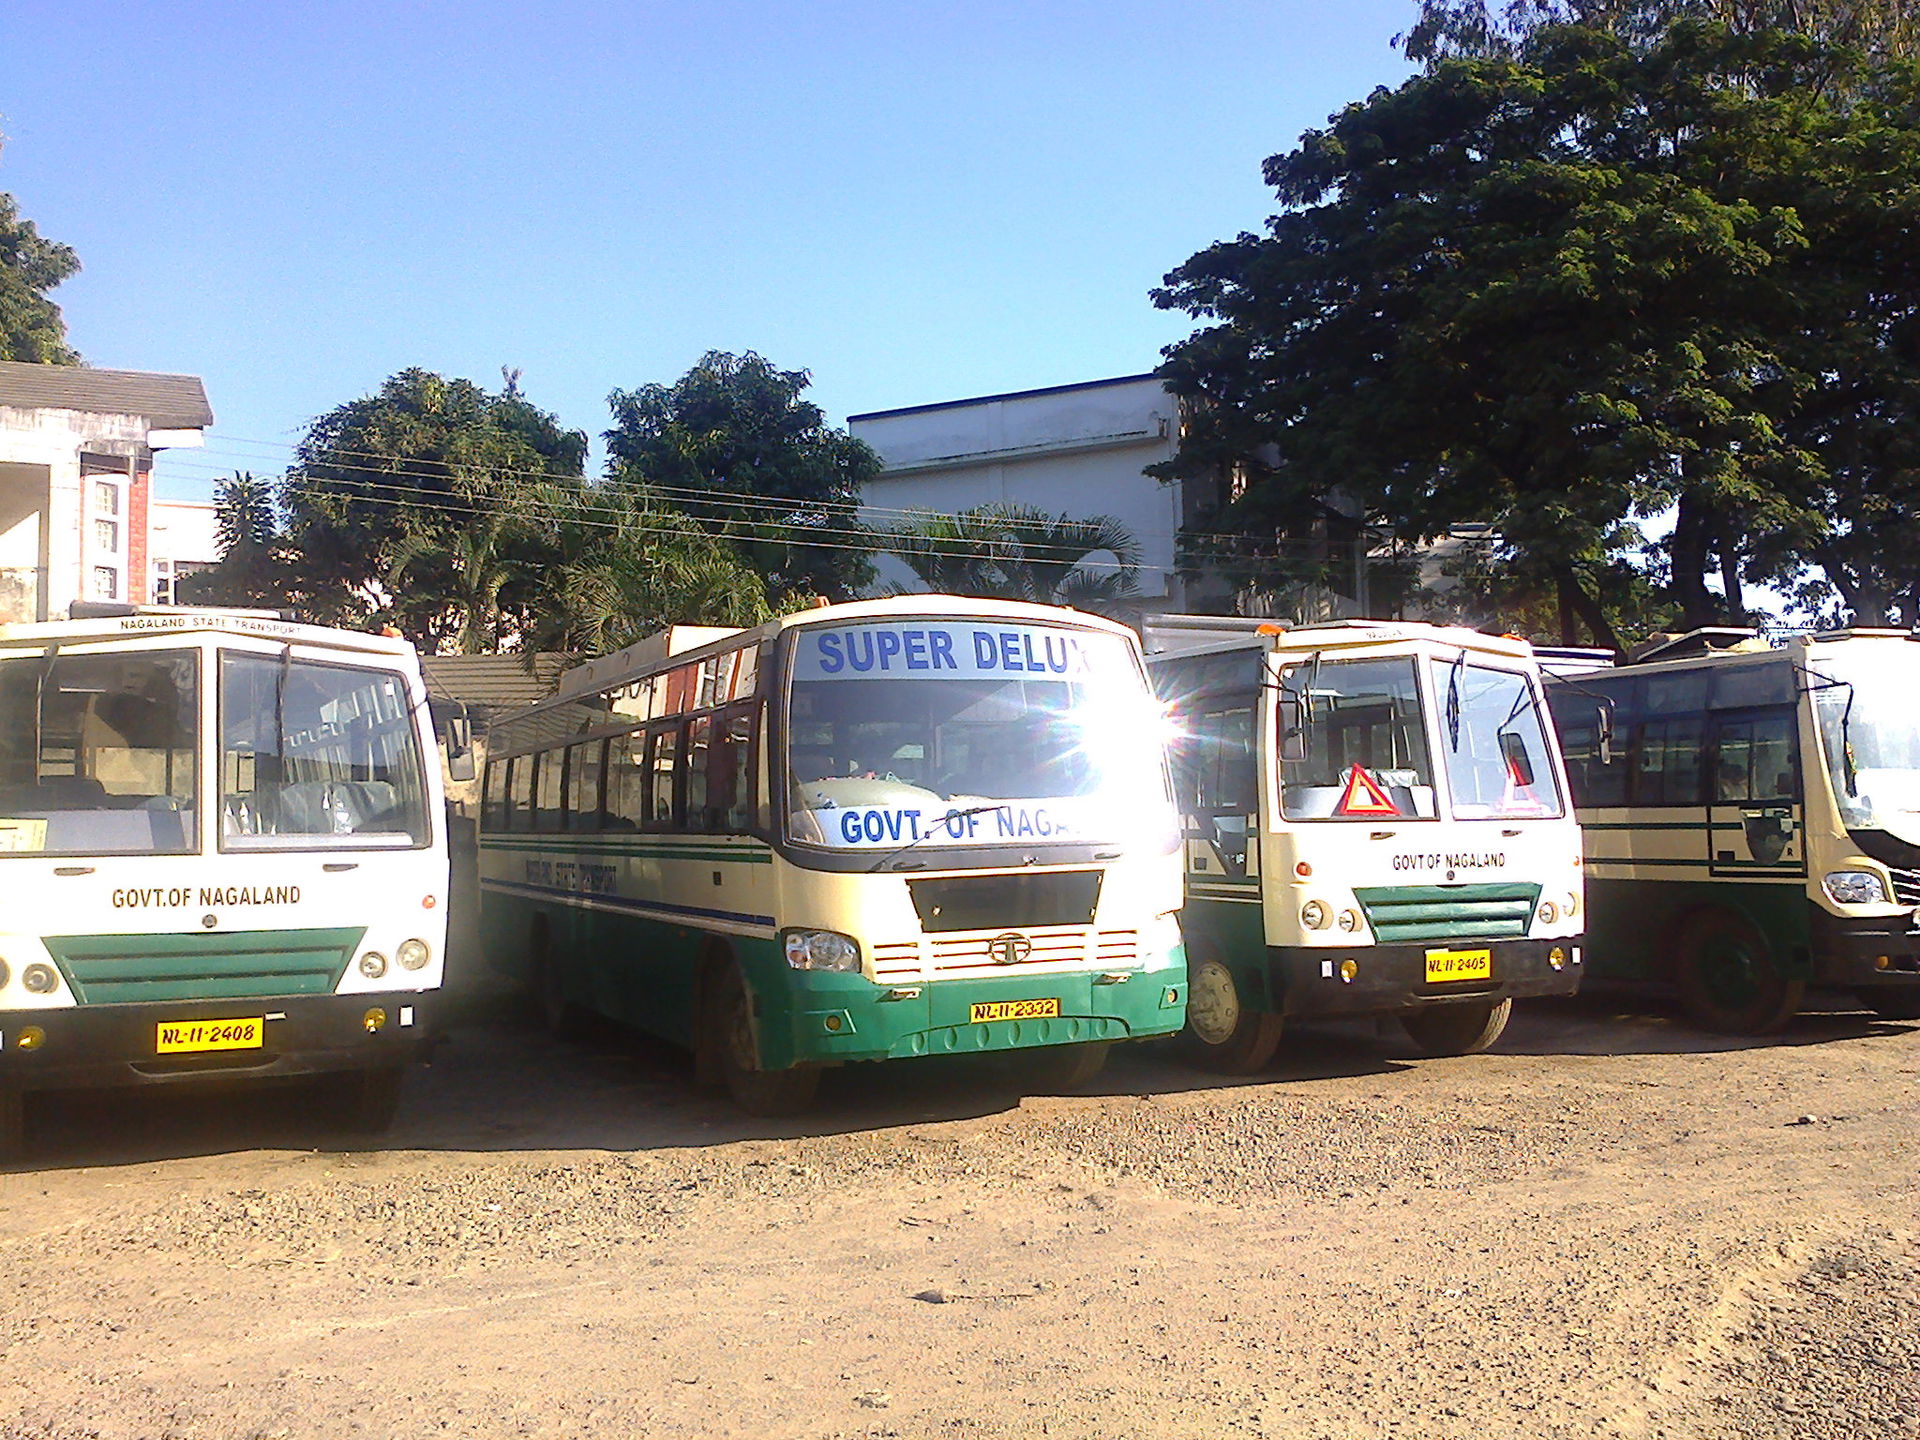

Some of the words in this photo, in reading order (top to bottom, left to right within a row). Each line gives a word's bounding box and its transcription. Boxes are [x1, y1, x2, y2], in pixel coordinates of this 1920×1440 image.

[120, 617, 186, 629] NAGALAND
[192, 617, 226, 628] STATE
[234, 619, 301, 634] TRANSPORT
[817, 630, 958, 673] SUPER
[946, 808, 980, 839] OF
[1445, 852, 1506, 868] NAGALAND
[199, 886, 301, 907] NAGALAND
